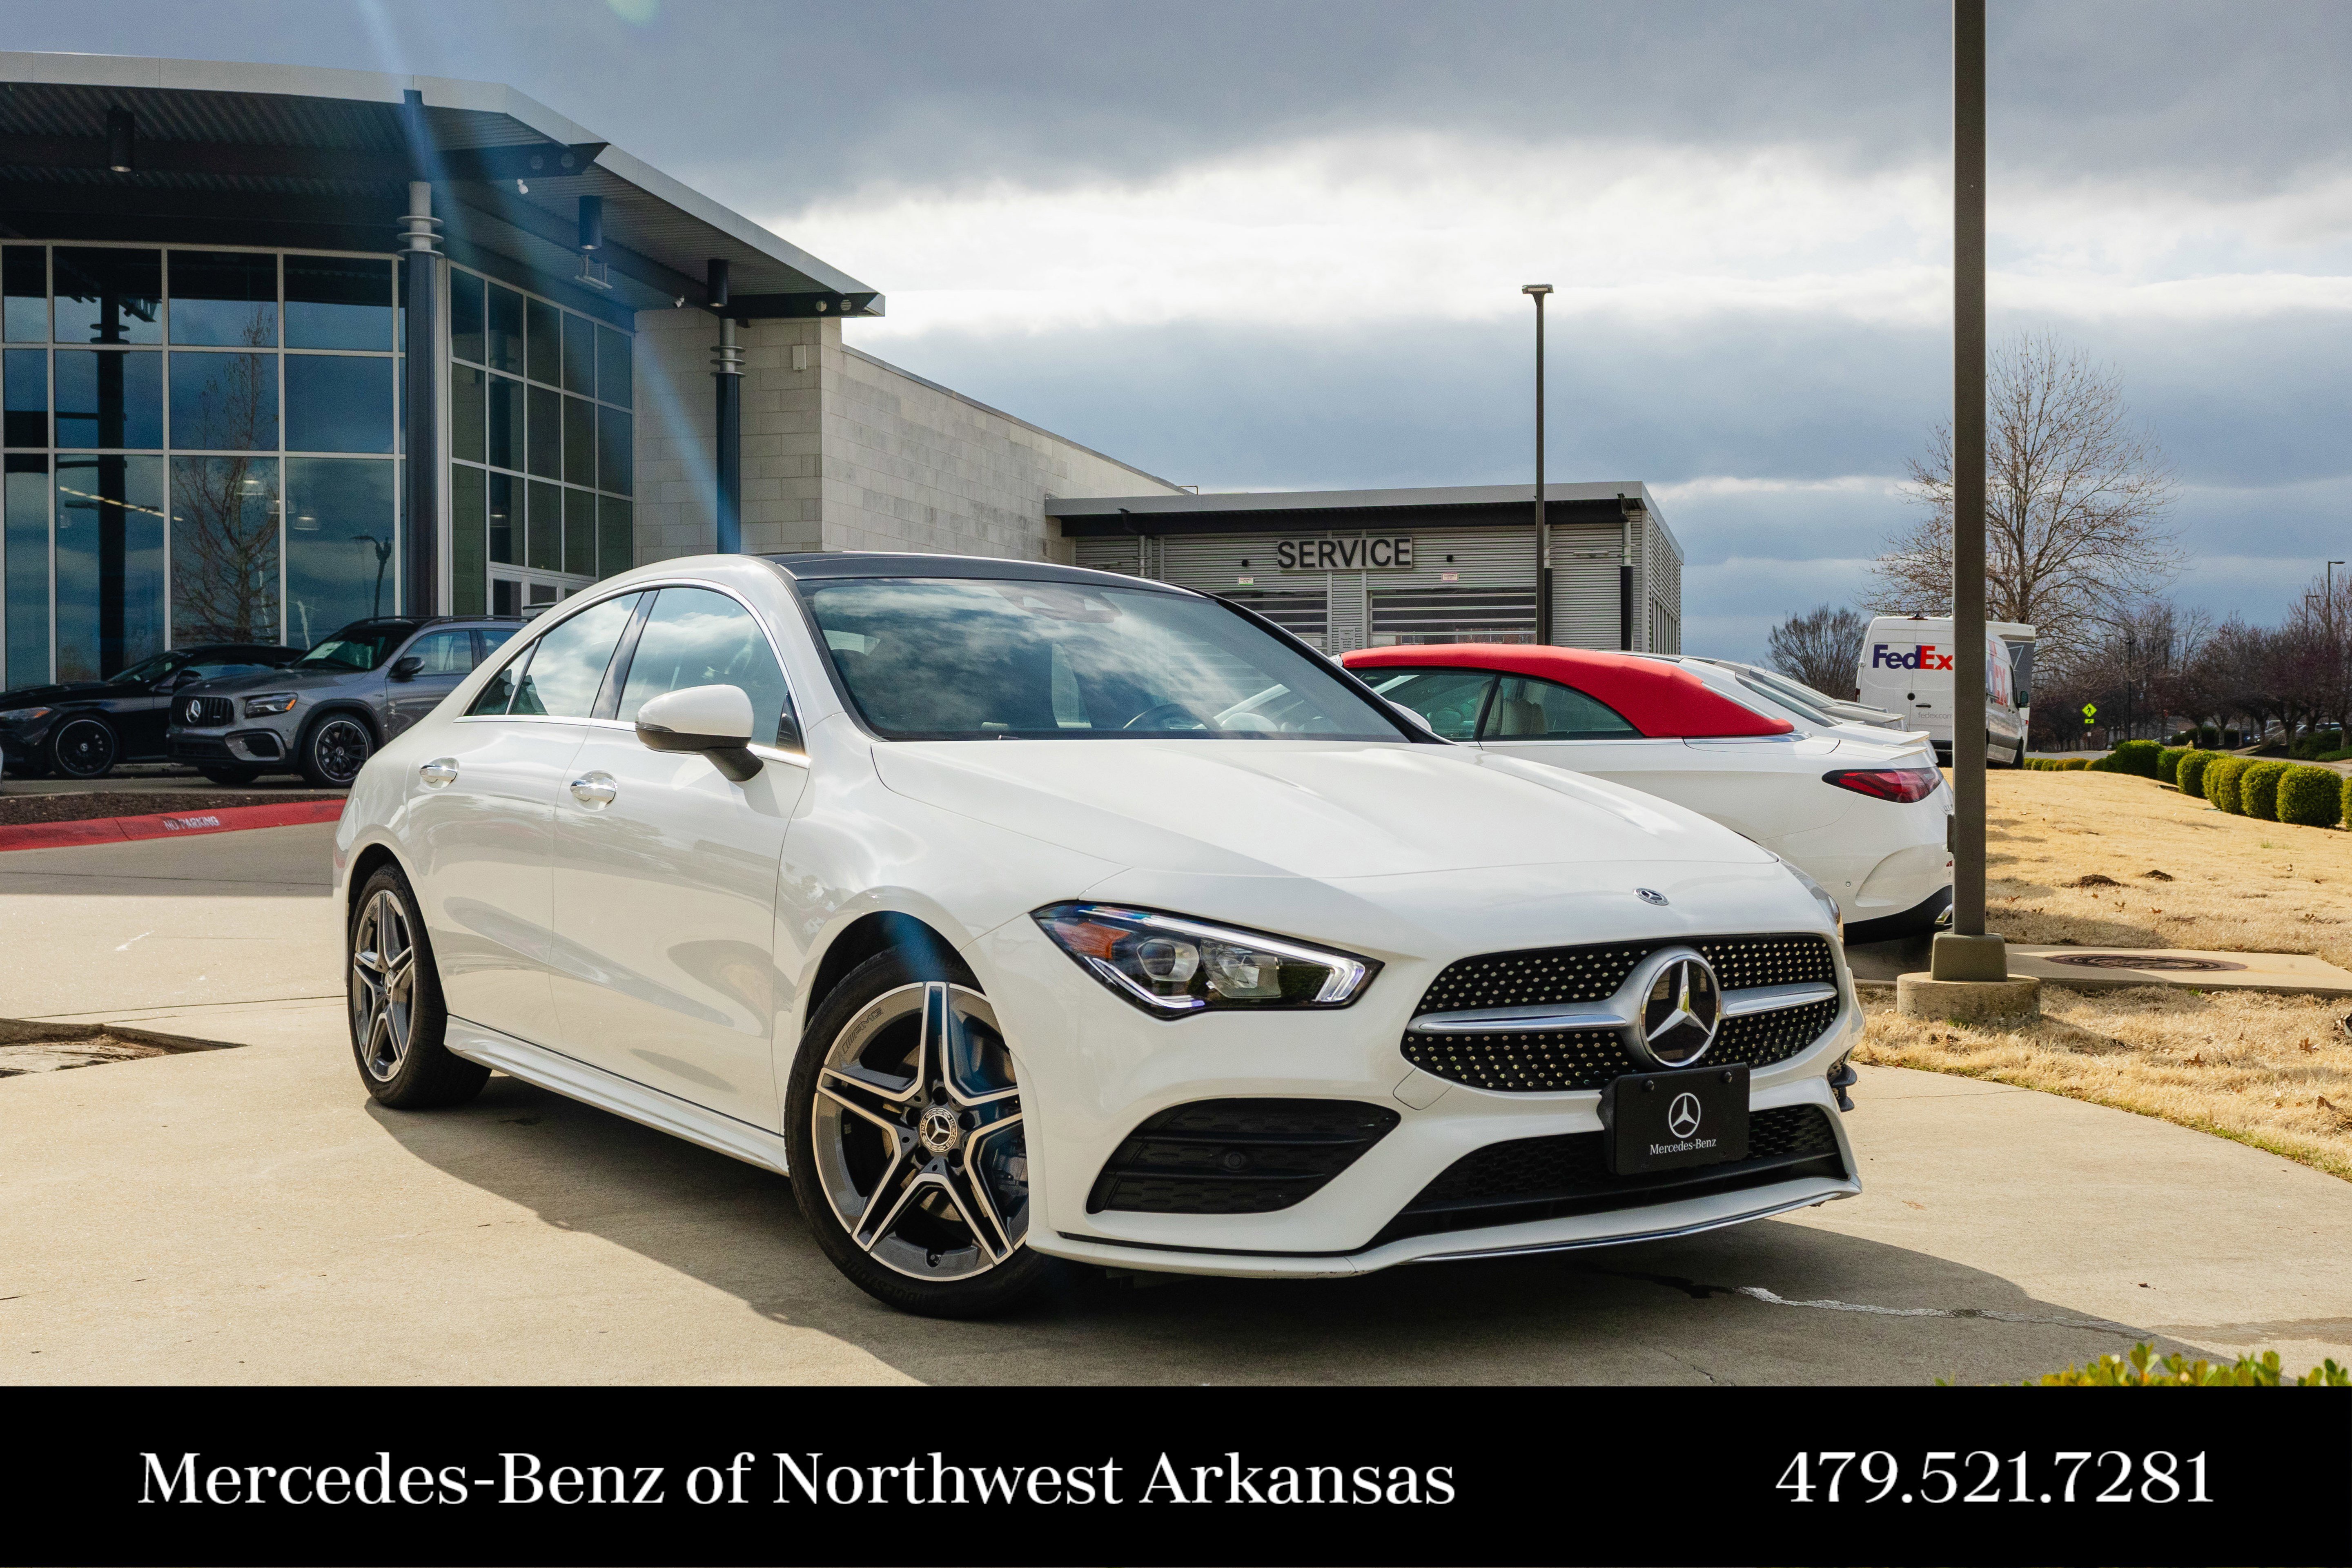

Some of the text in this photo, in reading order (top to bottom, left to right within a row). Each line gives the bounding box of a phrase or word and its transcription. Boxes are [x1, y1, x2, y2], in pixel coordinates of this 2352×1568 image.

[1278, 539, 1410, 568] SERVICE
[1873, 644, 1953, 670] FedEx
[163, 816, 220, 830] NO PARKING
[946, 1119, 956, 1147] MERCEDES
[1650, 1139, 1716, 1155] Mercedes-Benz
